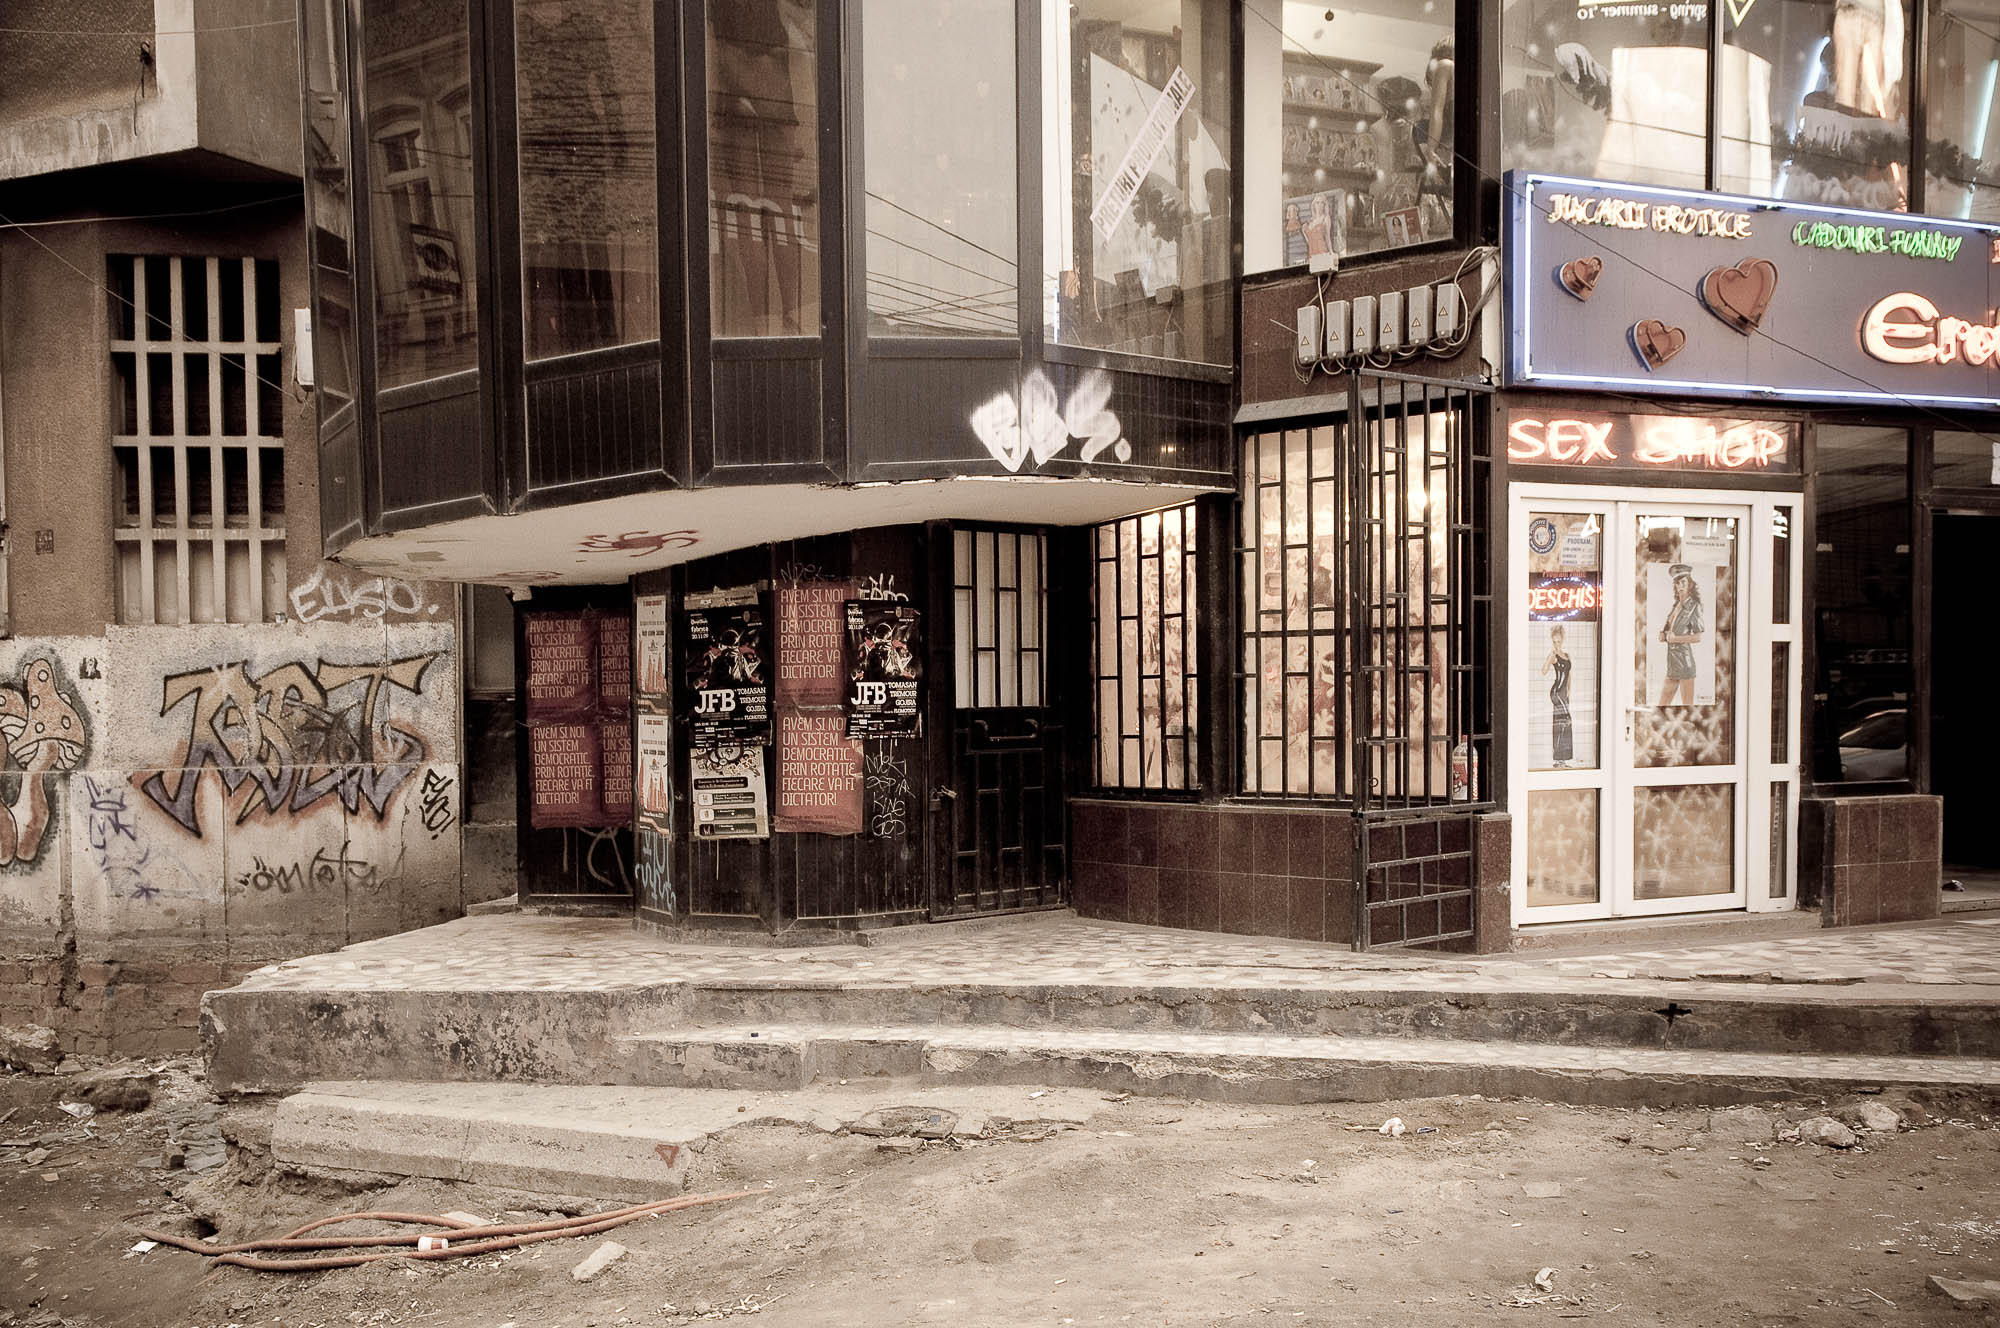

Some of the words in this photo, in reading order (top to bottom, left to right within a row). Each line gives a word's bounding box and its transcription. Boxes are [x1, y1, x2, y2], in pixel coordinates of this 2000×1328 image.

[1549, 194, 1649, 230] JUCARII
[1651, 204, 1752, 239] EROTICE
[1792, 221, 1888, 254] CADOURI
[1890, 229, 1963, 262] FUNNY
[1507, 418, 1618, 464] SEX
[1633, 424, 1784, 469] SHOP
[781, 588, 808, 603] AVEM
[825, 588, 844, 602] NOI
[1528, 587, 1596, 609] DESCHIS
[781, 604, 797, 618] UN
[799, 604, 836, 618] SISTEM
[530, 620, 553, 632] AVEM
[566, 619, 583, 631] NOI
[529, 633, 543, 646] UN
[545, 632, 575, 645] SISTEM
[780, 634, 806, 648] PRIN
[781, 649, 824, 663] FIECARE
[826, 649, 841, 662] VA
[531, 660, 551, 672] PRIN
[601, 658, 621, 671] PRIN
[781, 664, 836, 679] DICTATOR!
[531, 672, 565, 685] FIECARE
[566, 672, 579, 684] VA
[581, 672, 589, 685] FI
[530, 685, 575, 698] DICTATOR!
[850, 681, 887, 705] JFB
[887, 681, 918, 689] TOMASAN
[694, 688, 736, 714] JFB
[736, 687, 767, 695] TOMASAN
[783, 716, 813, 731] AVEM
[533, 727, 558, 740] AVEM
[569, 726, 586, 738] NOI
[603, 725, 628, 739] AVEM
[783, 732, 798, 746] UN
[801, 732, 839, 746] SISTEM
[534, 741, 547, 753] UN
[549, 740, 579, 752] SISTEM
[603, 738, 617, 751] UN
[535, 766, 555, 779] PRIN
[604, 765, 625, 778] PRIN
[782, 762, 807, 776] PRIN
[535, 779, 569, 792] FIECARE
[571, 779, 583, 790] VA
[585, 778, 593, 790] FI
[782, 777, 826, 791] FIECARE
[827, 777, 842, 790] VA
[845, 777, 855, 790] FI
[536, 791, 580, 805] DICTATOR!
[782, 792, 837, 806] DICTATOR!
